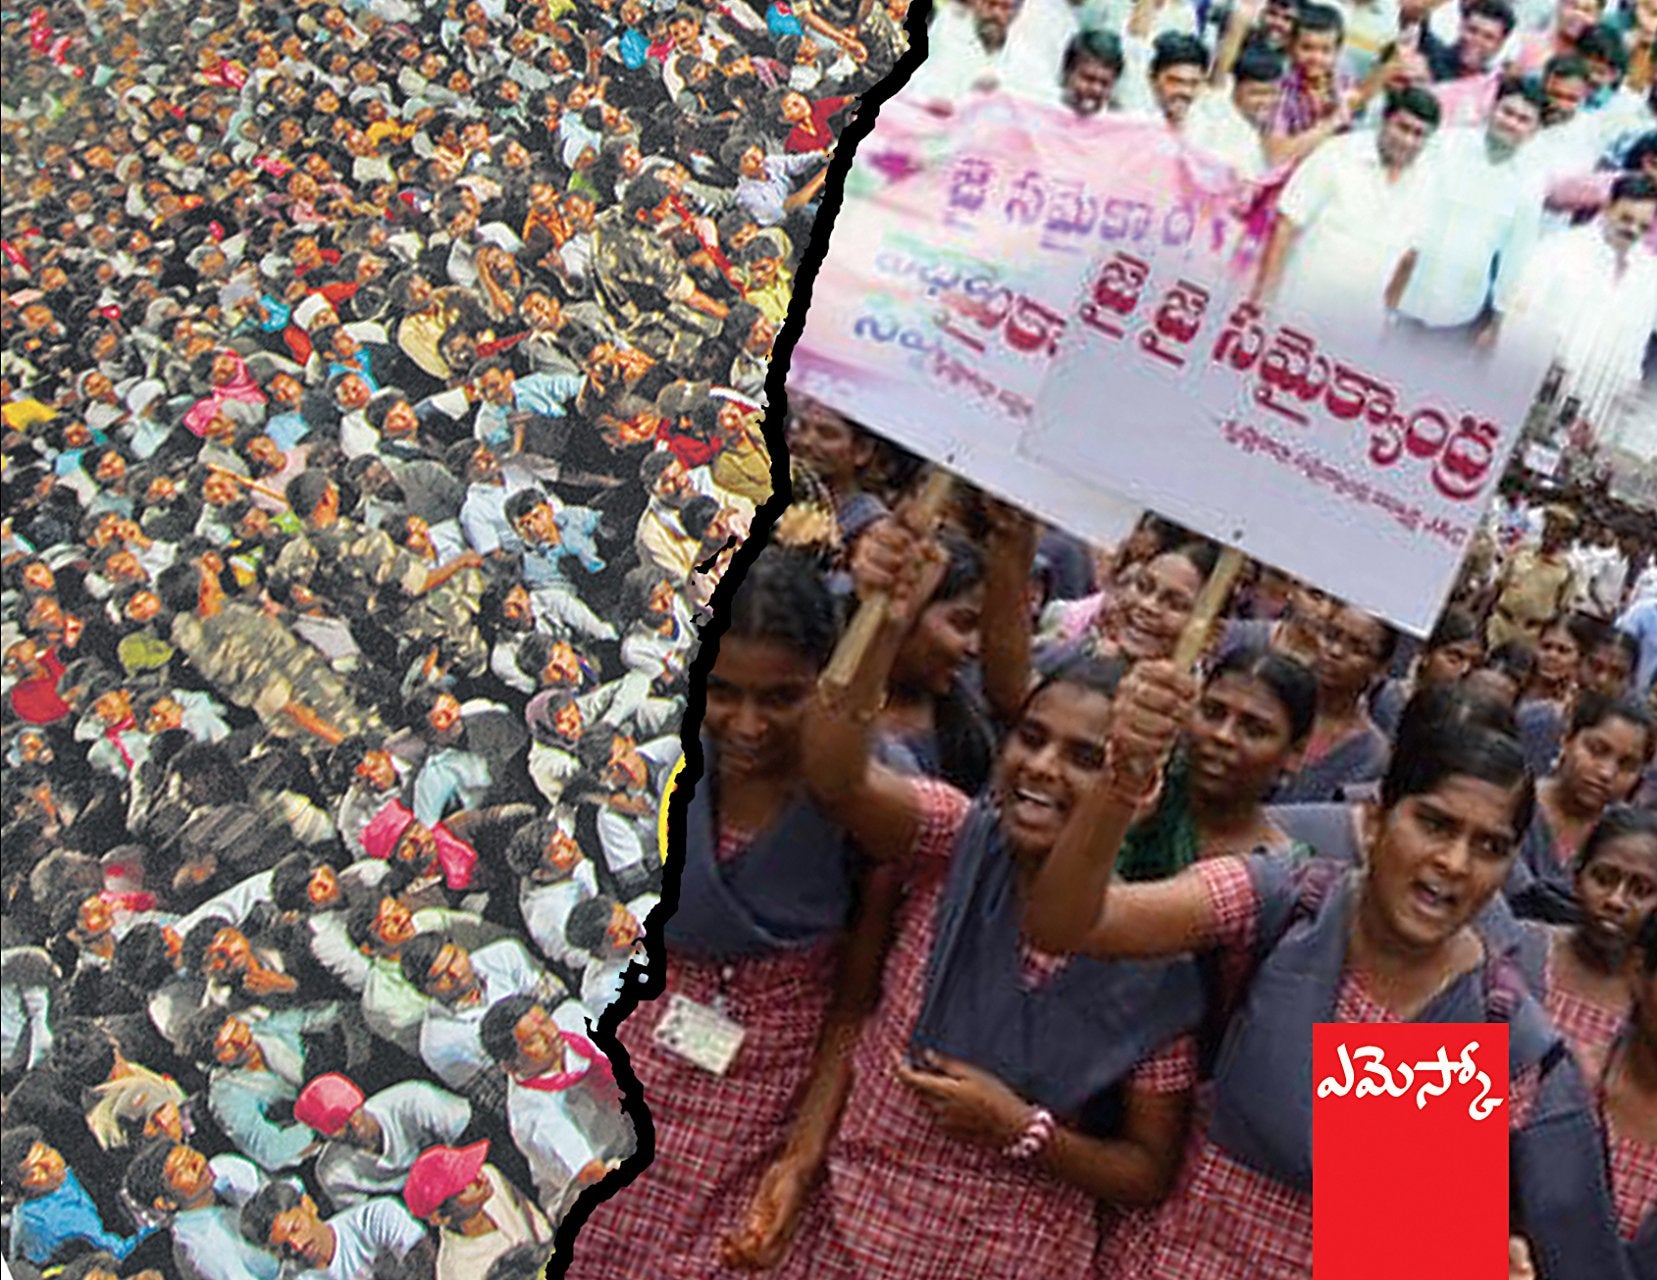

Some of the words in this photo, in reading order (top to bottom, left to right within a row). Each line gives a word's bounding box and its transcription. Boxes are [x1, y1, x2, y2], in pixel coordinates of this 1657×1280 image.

[1080, 250, 1149, 340] జై
[1139, 279, 1210, 367] జై
[1317, 1041, 1504, 1121] ఎమెస్కో
